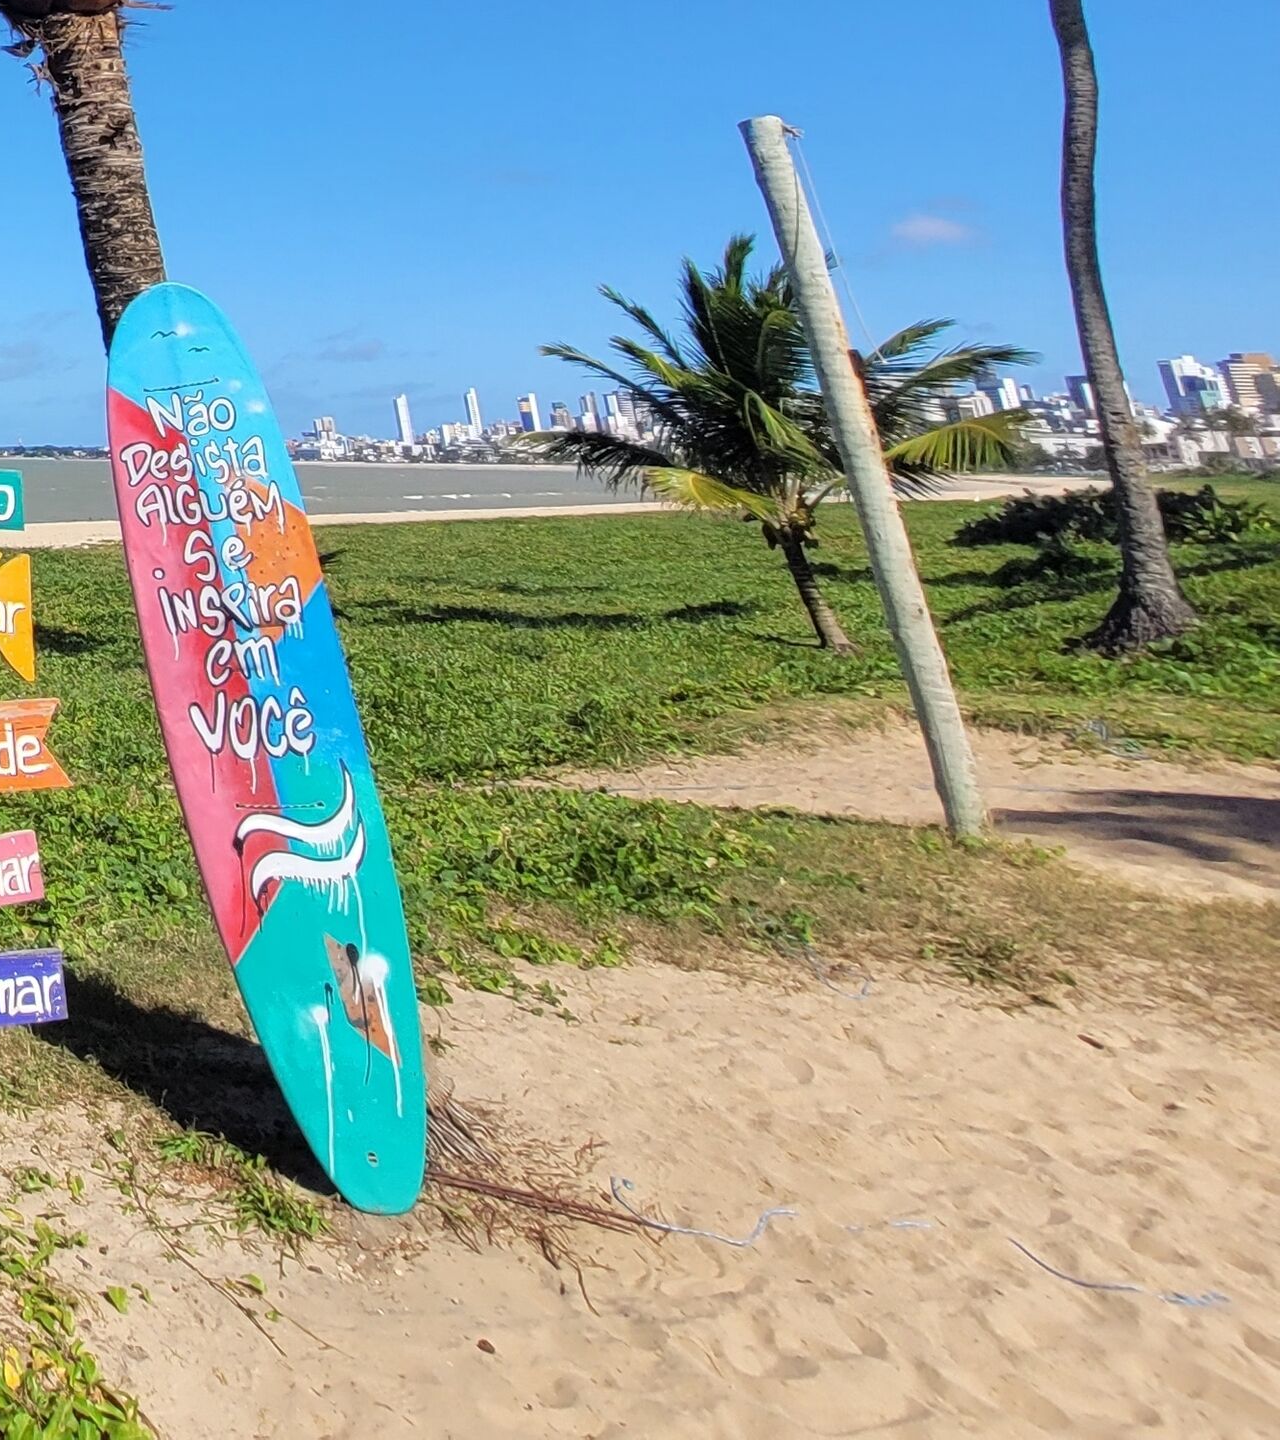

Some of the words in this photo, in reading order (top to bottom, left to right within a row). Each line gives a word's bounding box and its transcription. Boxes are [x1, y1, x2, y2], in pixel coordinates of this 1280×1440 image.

[145, 390, 235, 439] Não
[121, 435, 270, 487] Desista
[184, 530, 252, 582] Se
[205, 635, 280, 686] em
